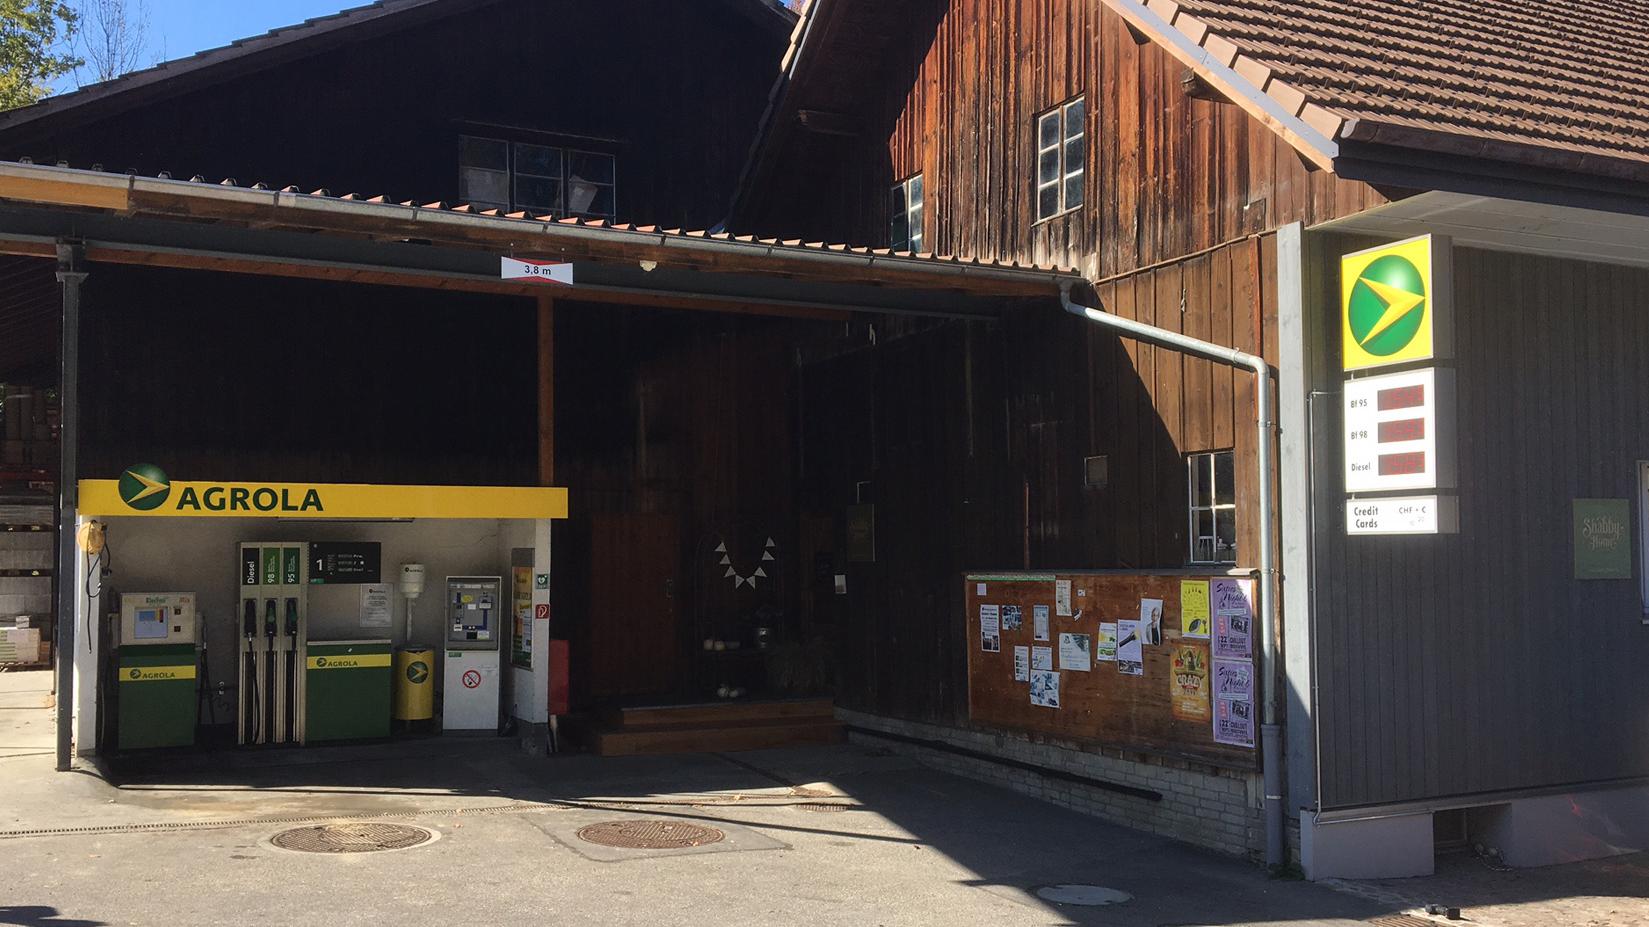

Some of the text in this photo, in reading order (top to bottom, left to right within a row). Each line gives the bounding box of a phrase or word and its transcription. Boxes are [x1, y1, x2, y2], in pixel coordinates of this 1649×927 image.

[1359, 399, 1368, 407] 95
[1359, 431, 1368, 439] 98
[1351, 462, 1371, 471] Diesel
[176, 487, 324, 512] AGROLA
[1354, 505, 1378, 516] Credit
[1398, 506, 1413, 514] CHF
[1355, 518, 1378, 528] Cards
[1583, 517, 1623, 540] Shabby
[316, 559, 323, 571] 1
[247, 561, 255, 584] Diesel
[267, 573, 275, 583] 98
[287, 573, 296, 583] 95
[142, 672, 176, 680] AGROLA
[1221, 719, 1228, 727] 22
